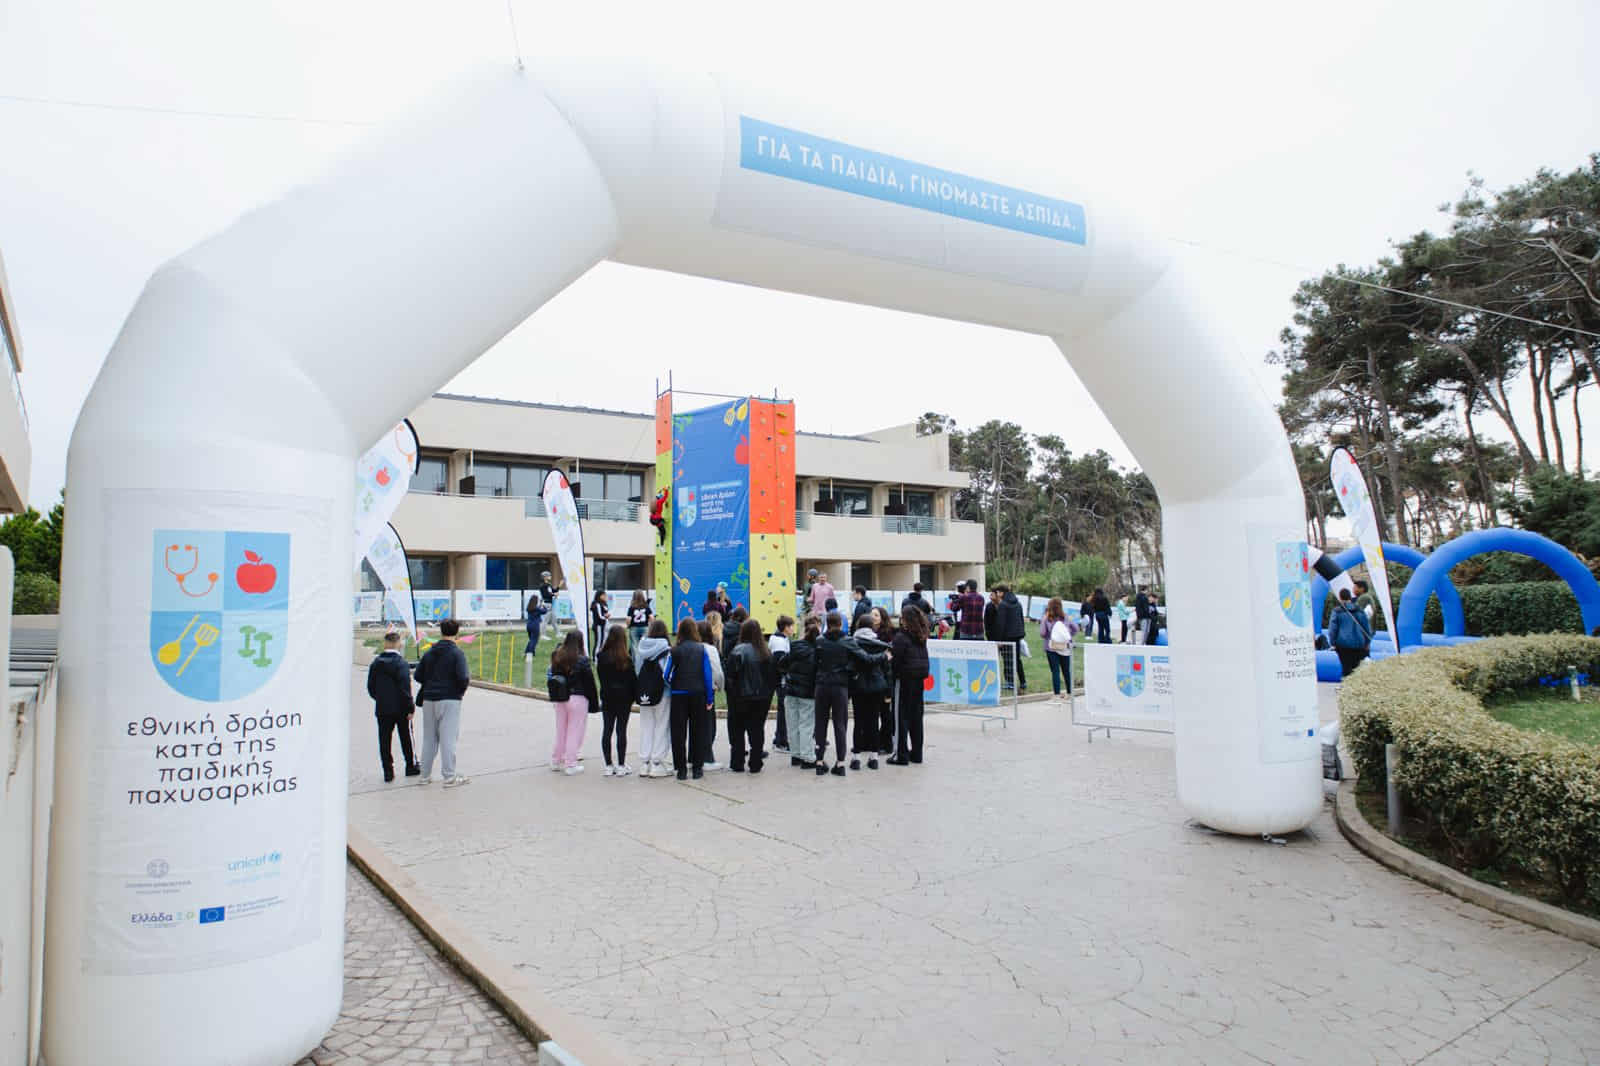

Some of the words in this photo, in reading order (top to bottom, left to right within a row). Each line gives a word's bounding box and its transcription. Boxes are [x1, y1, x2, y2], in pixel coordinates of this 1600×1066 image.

[756, 135, 792, 162] ΓΙΑ
[798, 145, 825, 171] ΤΑ
[831, 154, 905, 193] ΠΑΙΔΙΑ,
[910, 175, 1010, 215] ΓΙΝΟΜΑΣΤΕ
[1015, 199, 1078, 231] ΑΣΠΙΔΑ.
[127, 713, 215, 736] εθνική
[225, 709, 303, 738] δράση
[156, 736, 223, 759] κατά
[233, 737, 276, 755] της
[159, 756, 273, 783] παιδικής
[127, 775, 297, 805] παχυσαρκίας
